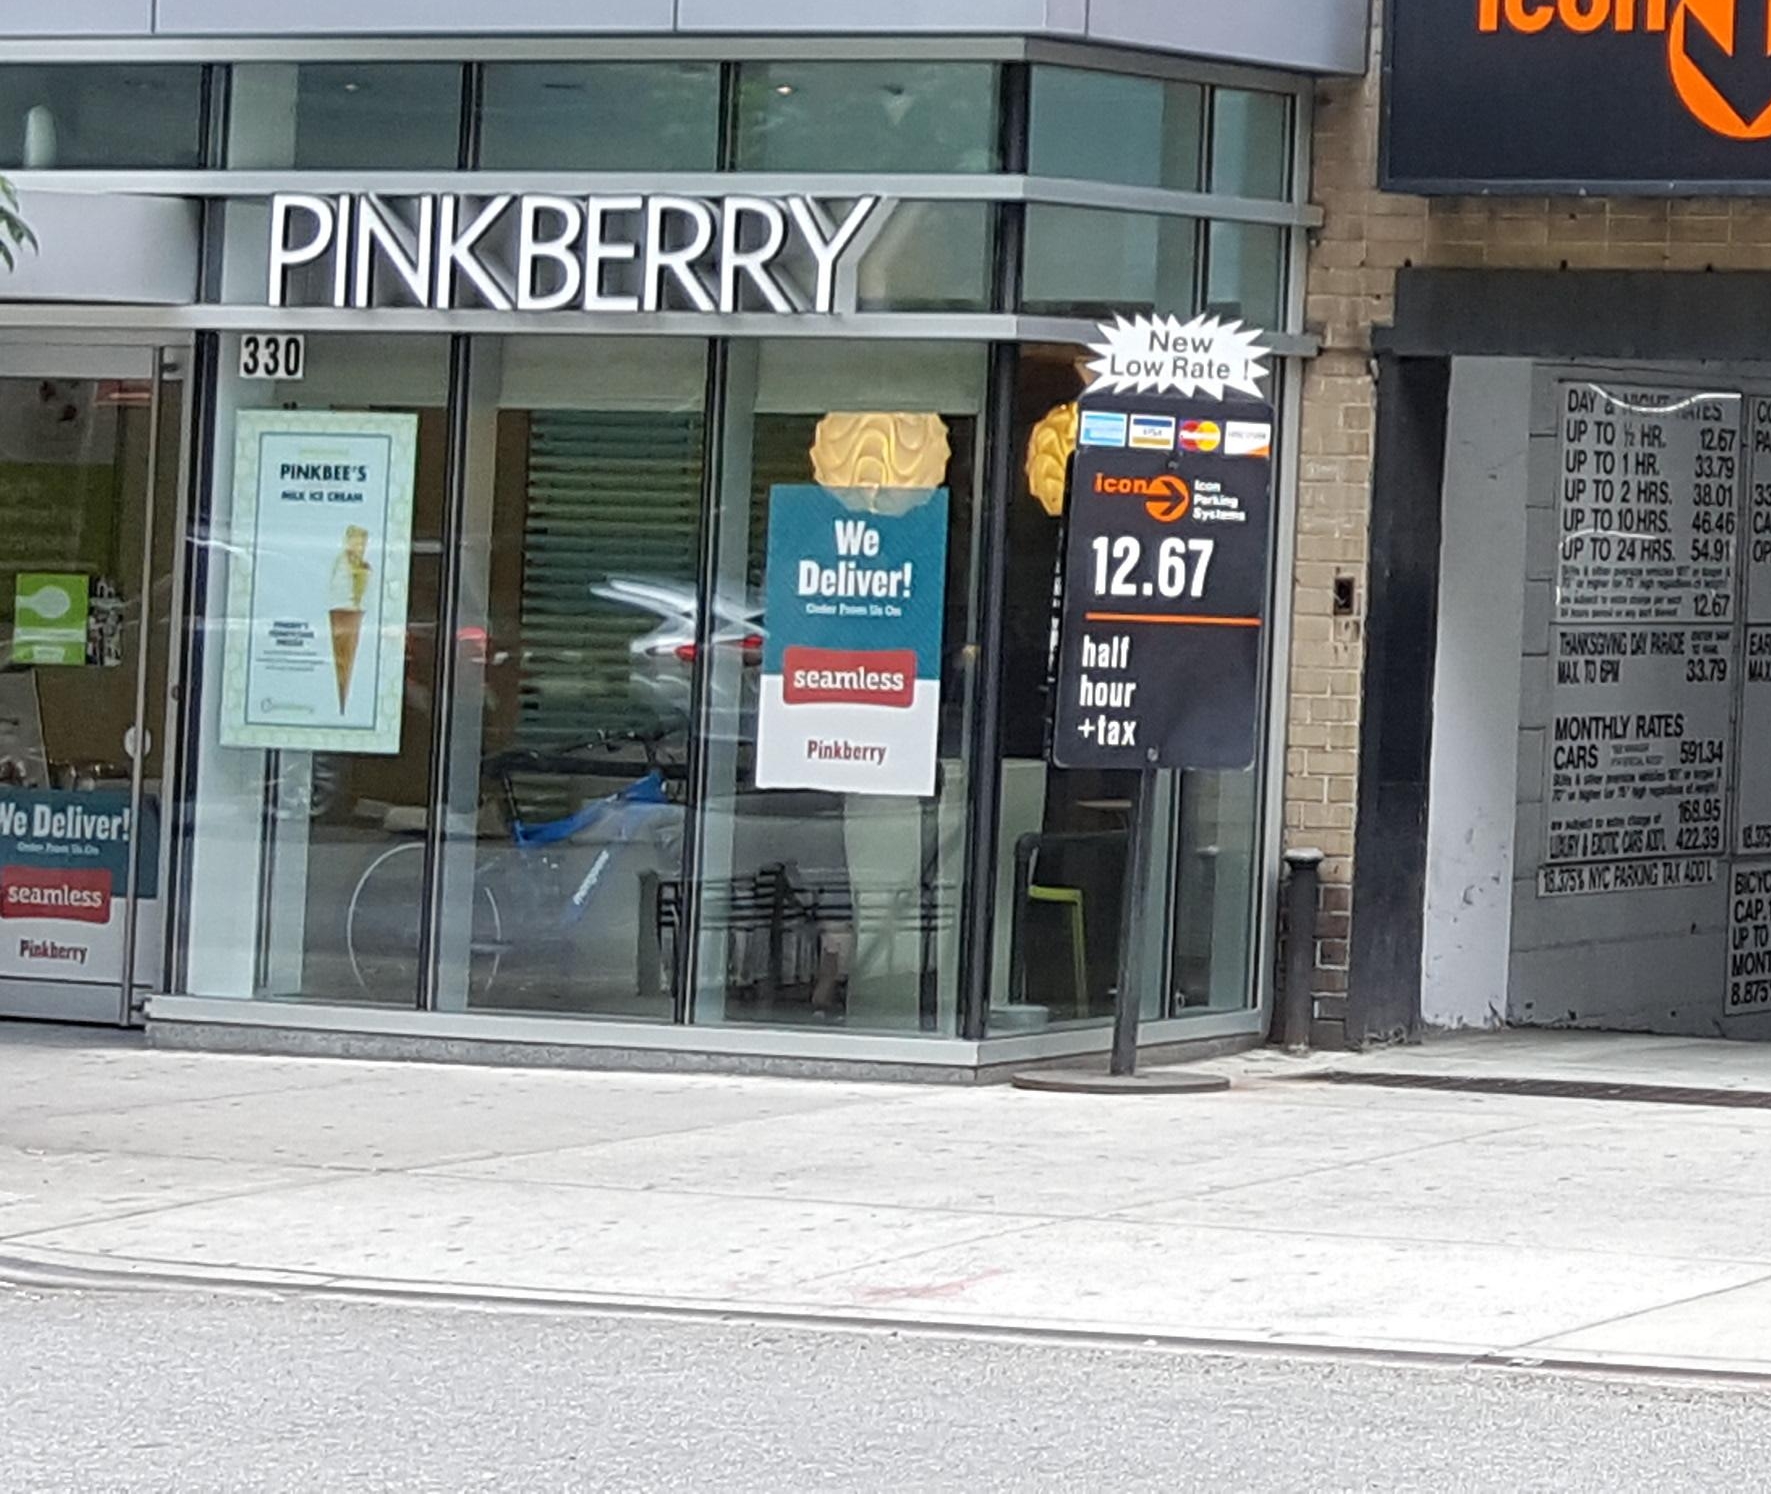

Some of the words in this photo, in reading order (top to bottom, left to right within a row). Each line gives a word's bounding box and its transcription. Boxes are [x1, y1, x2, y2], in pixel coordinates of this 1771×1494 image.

[268, 193, 876, 313] PINKBERRY
[1149, 330, 1214, 353] New
[242, 339, 301, 376] 330
[1110, 354, 1164, 377] Low
[1172, 356, 1231, 380] Rate
[1568, 389, 1597, 413] DAY
[1566, 420, 1588, 443] UP
[1594, 421, 1615, 446] TO
[1641, 424, 1667, 448] HR.
[1700, 428, 1737, 452] 12.67
[280, 464, 367, 482] PINKBEE'S
[1565, 449, 1588, 473] UP
[1593, 451, 1615, 475] TO
[1635, 453, 1660, 476] HR.
[1695, 456, 1735, 479] 33.79
[1094, 473, 1148, 493] icon
[1564, 479, 1586, 502] UP
[1593, 479, 1614, 503] TO
[1621, 480, 1631, 503] 2
[1637, 481, 1672, 505] HRS.
[1693, 484, 1733, 507] 38.01
[1194, 494, 1238, 508] Parking
[1192, 507, 1246, 522] Systems
[1563, 508, 1585, 532] UP
[1591, 508, 1612, 532] TO
[1618, 508, 1634, 531] 10
[1637, 509, 1672, 533] HRS.
[1692, 511, 1736, 535] 46.46
[834, 519, 880, 556] We
[1562, 537, 1584, 561] UP
[1591, 537, 1611, 561] TO
[1617, 539, 1636, 561] 24
[1640, 539, 1676, 562] HRS.
[1691, 538, 1730, 562] 54.91
[798, 559, 913, 598] Deliver!
[1092, 535, 1215, 597] 12.67
[1694, 594, 1730, 617] 12.67
[1082, 634, 1131, 669] half
[793, 666, 904, 691] seamless
[1686, 658, 1727, 682] 33.79
[1079, 674, 1137, 707] hour
[1077, 714, 1137, 746] +tax
[1555, 714, 1632, 741] MONTHLY
[1636, 713, 1684, 737] RATES
[807, 740, 886, 765] Pinkberry
[1554, 743, 1599, 770] CARS
[1680, 740, 1723, 764] 591.34
[33, 804, 130, 840] Deliver!
[1675, 826, 1720, 850] 422.39
[1589, 865, 1611, 890] NYC
[1614, 862, 1658, 888] PARKING
[1663, 861, 1680, 884] TAX
[7, 885, 103, 908] seamless
[1733, 926, 1748, 950] UP
[1753, 925, 1768, 947] TO
[20, 939, 88, 964] Pinkberry
